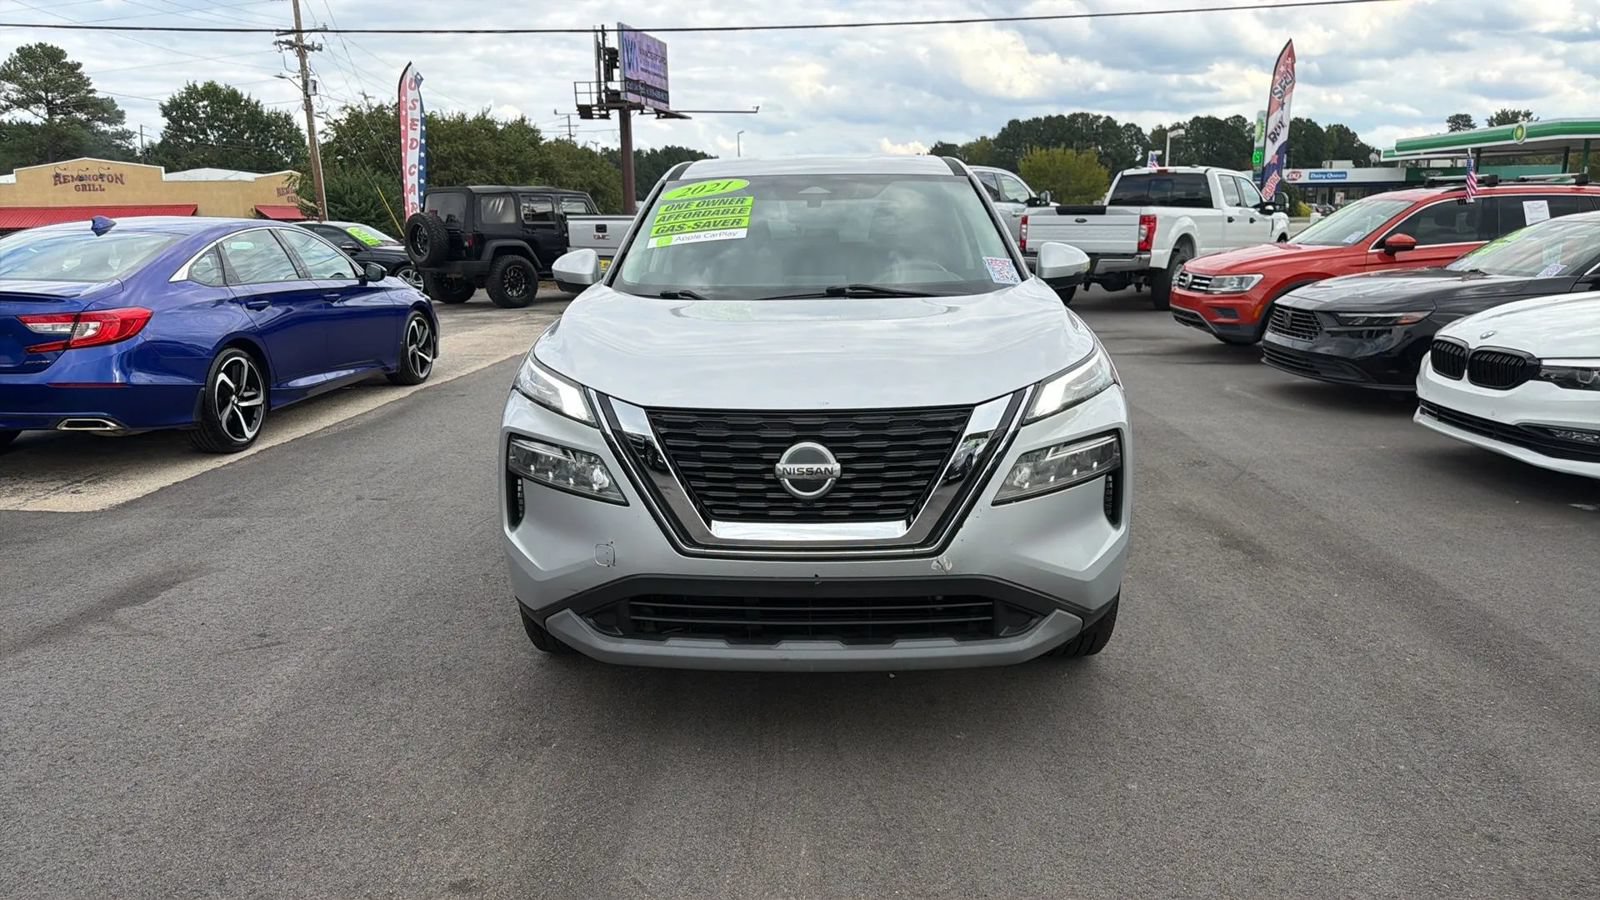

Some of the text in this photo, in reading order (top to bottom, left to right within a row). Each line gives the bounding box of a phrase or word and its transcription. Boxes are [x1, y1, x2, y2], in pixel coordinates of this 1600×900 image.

[408, 78, 419, 151] USED
[53, 173, 125, 186] REMINGTON
[74, 184, 106, 192] GRILL
[674, 181, 733, 198] 2021
[664, 197, 746, 212] ONE OWNER
[656, 207, 749, 223] AFFORDABLE
[675, 231, 738, 242] Apple CarPlay
[782, 467, 834, 475] NISSAN
